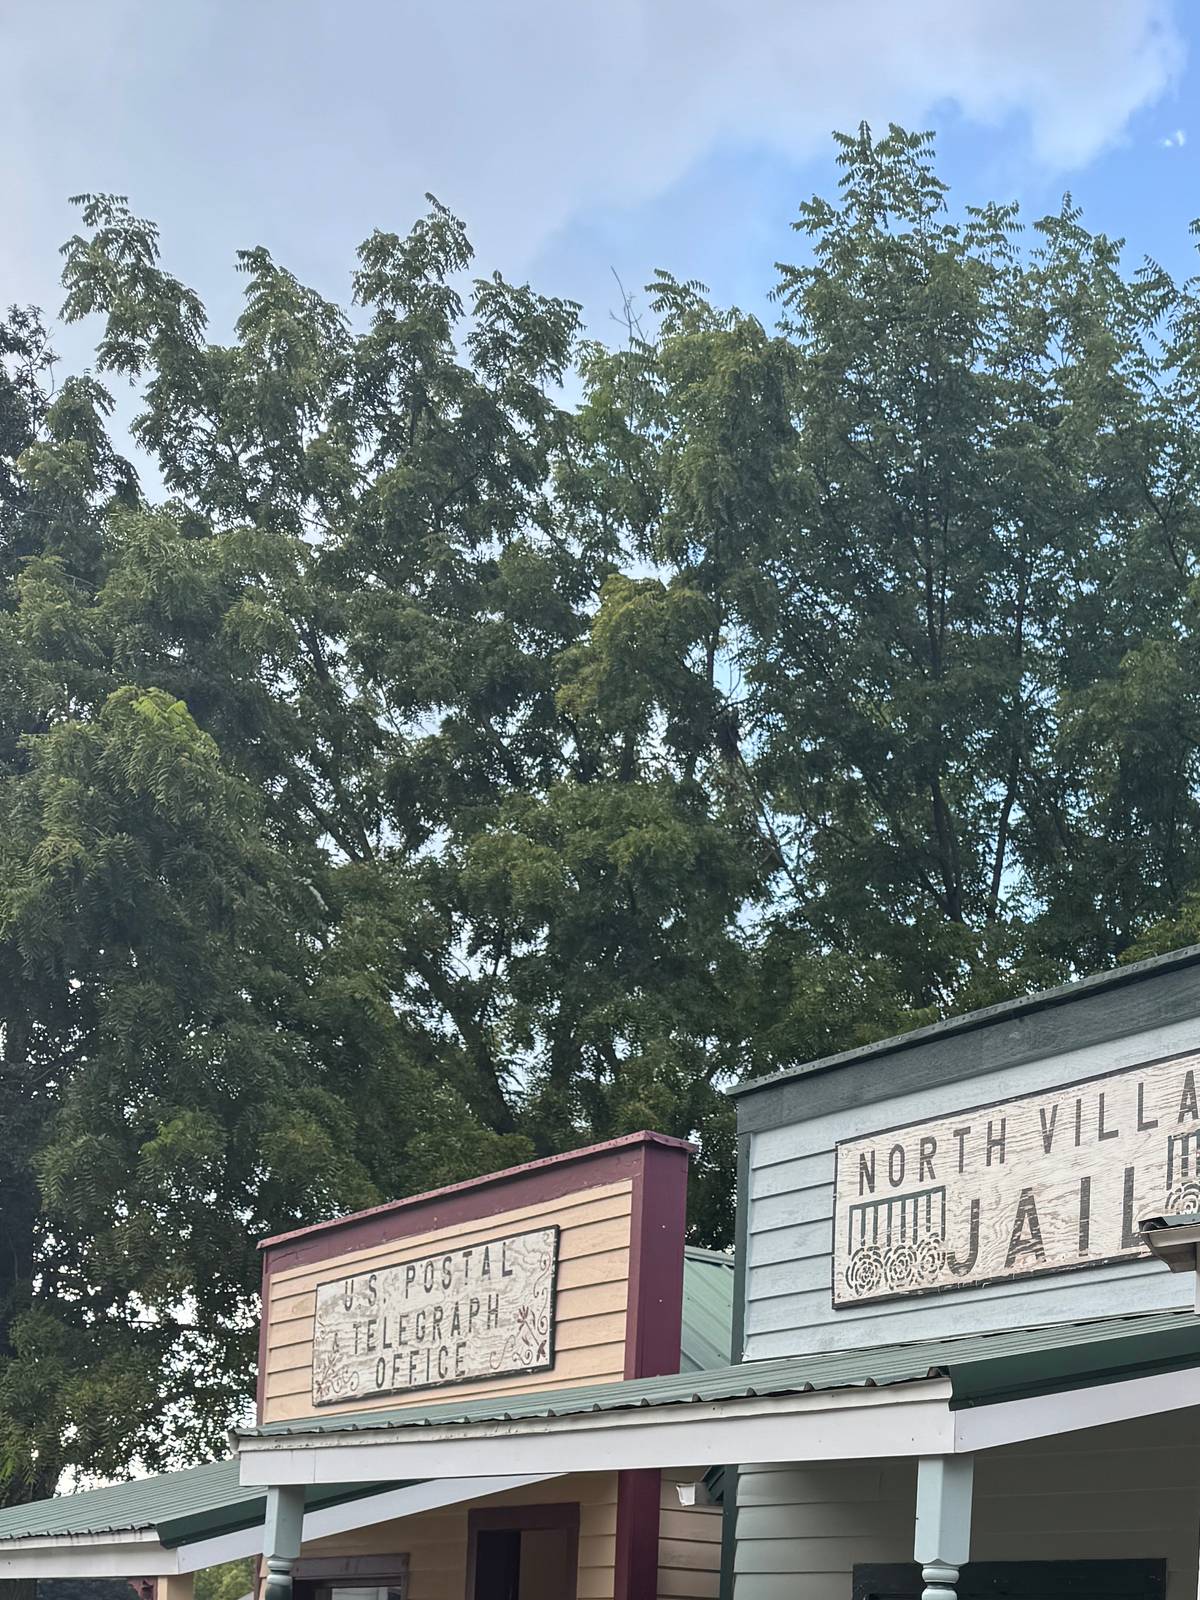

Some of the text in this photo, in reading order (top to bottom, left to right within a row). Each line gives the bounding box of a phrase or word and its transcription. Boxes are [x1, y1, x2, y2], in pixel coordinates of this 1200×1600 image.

[858, 1117, 1006, 1196] NORTH
[946, 1166, 1148, 1277] JAIL
[405, 1241, 514, 1299] POSTAL
[352, 1293, 500, 1355] TELEGRAPH
[375, 1341, 468, 1389] OFFICE
